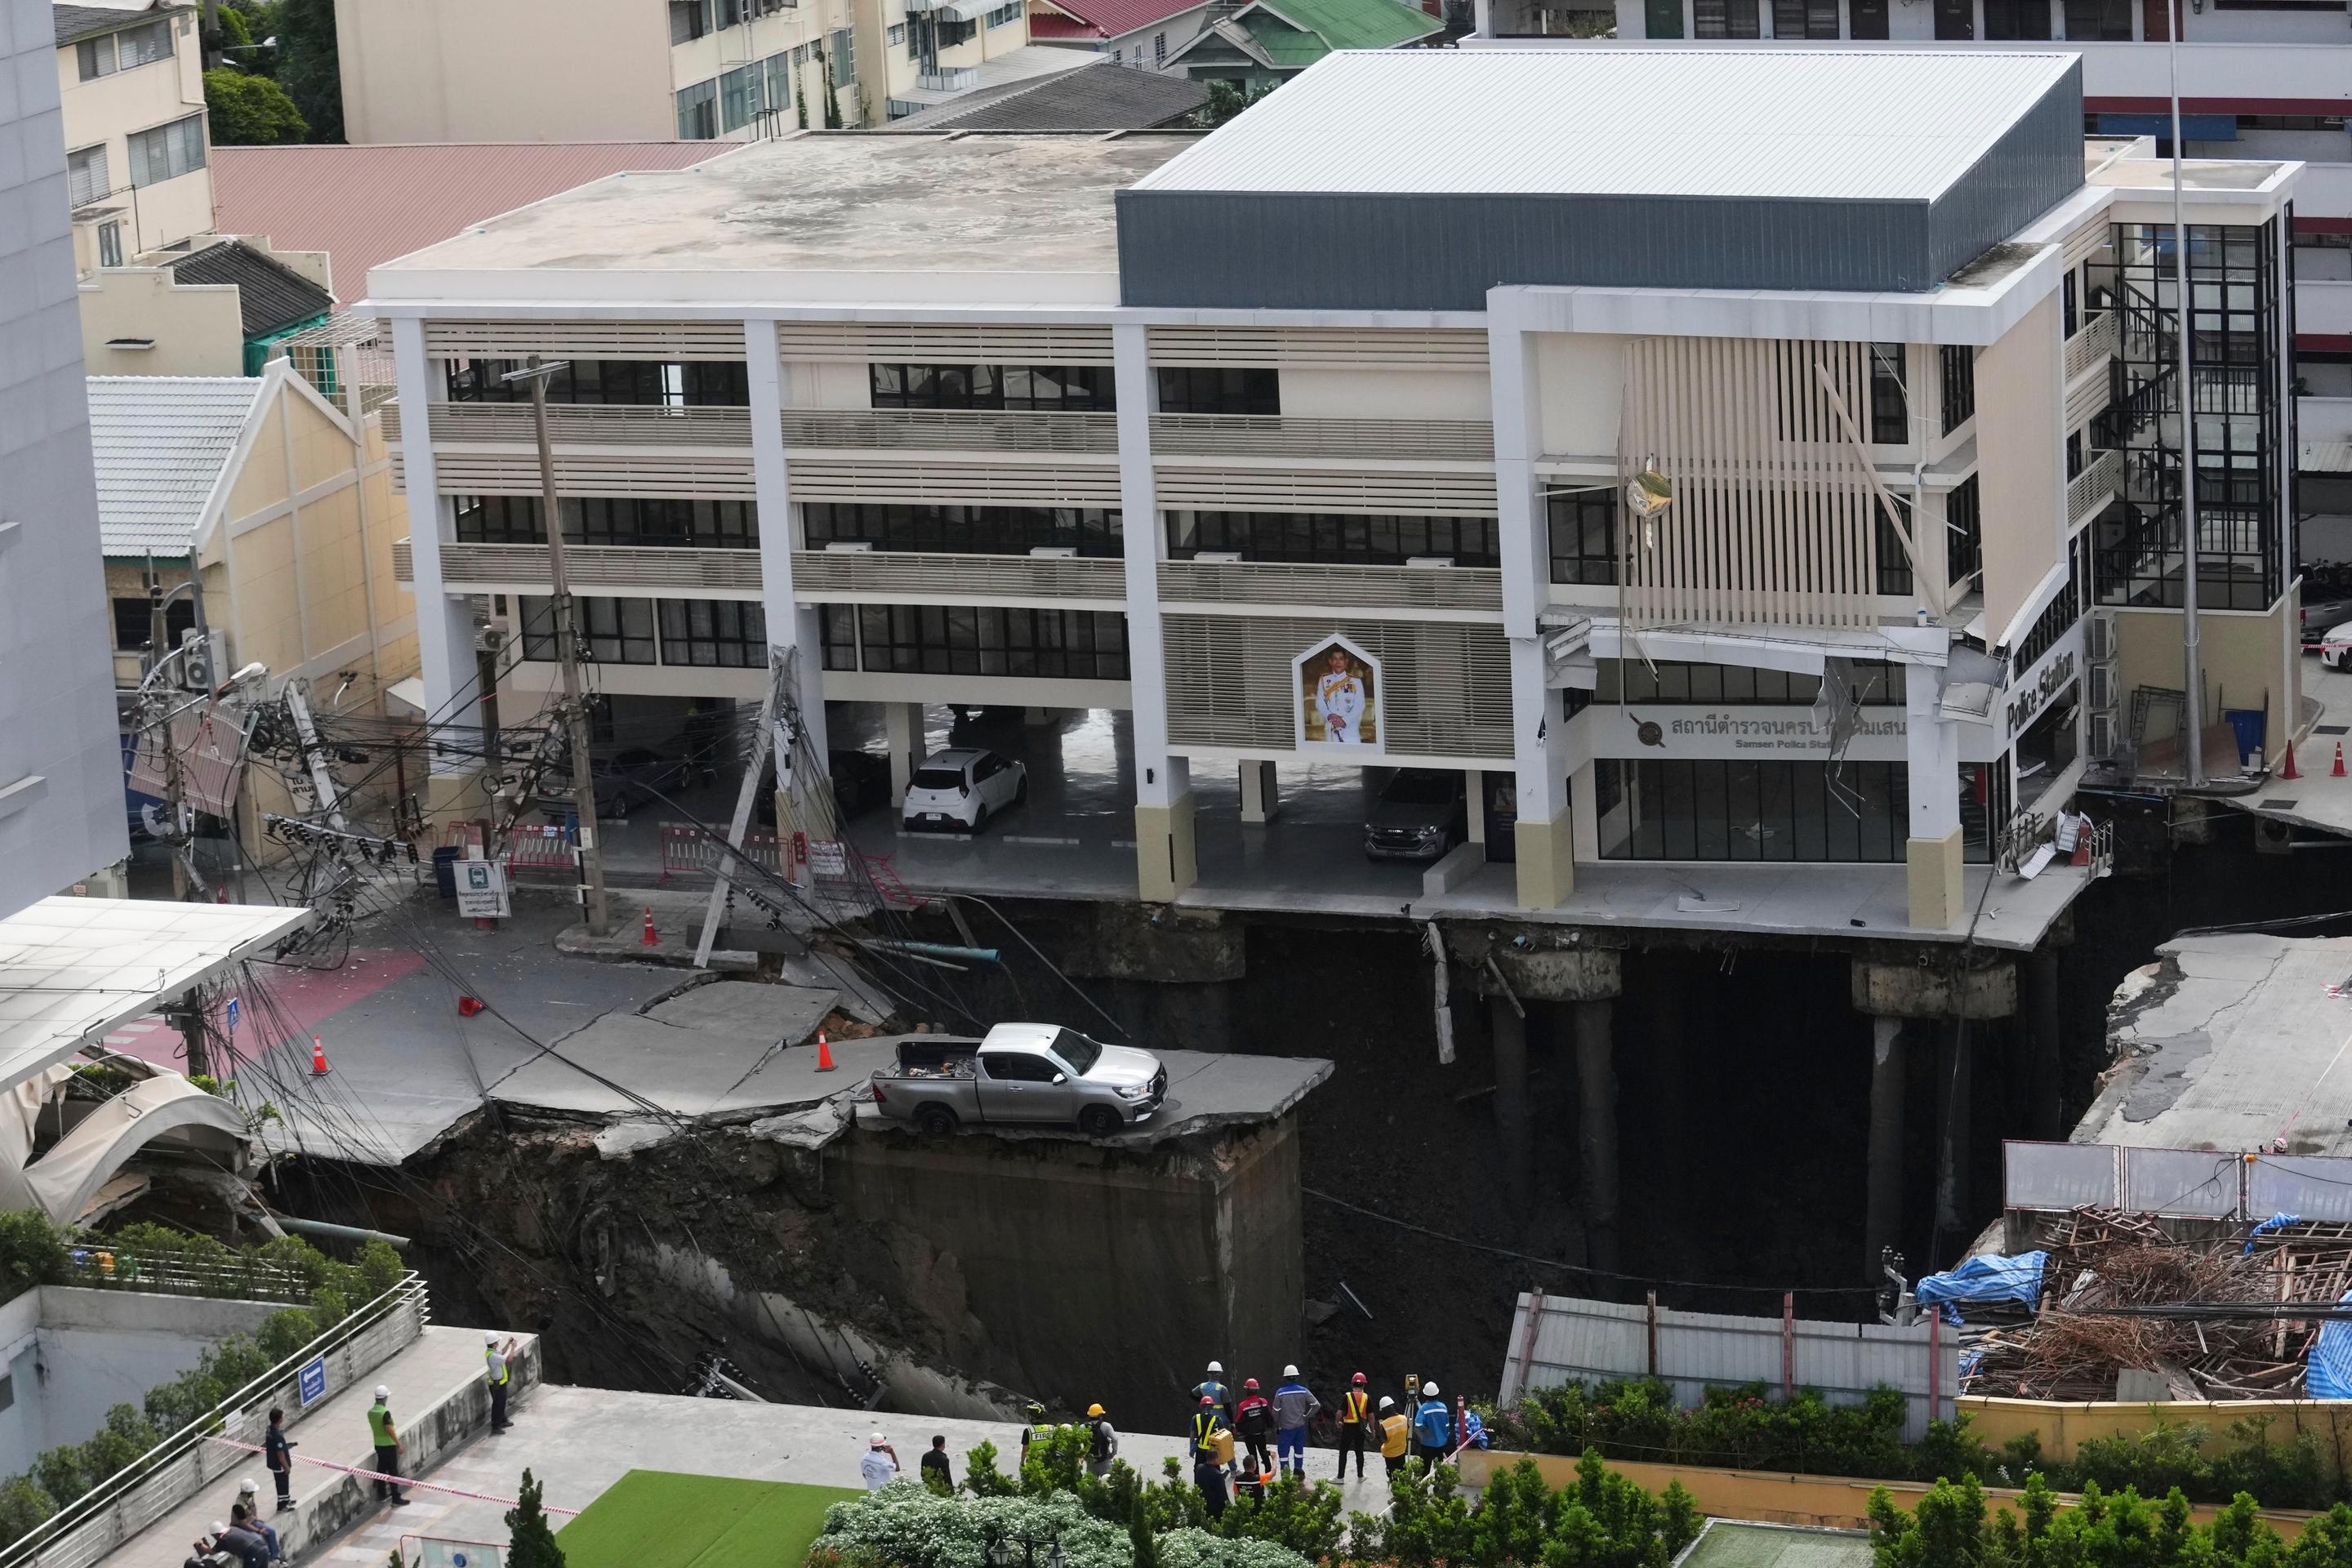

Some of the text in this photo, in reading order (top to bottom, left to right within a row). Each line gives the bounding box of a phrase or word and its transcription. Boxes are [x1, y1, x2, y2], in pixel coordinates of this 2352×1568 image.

[2007, 651, 2074, 740] Police Station
[1735, 740, 1775, 749] Samsen
[1777, 740, 1807, 749] Police
